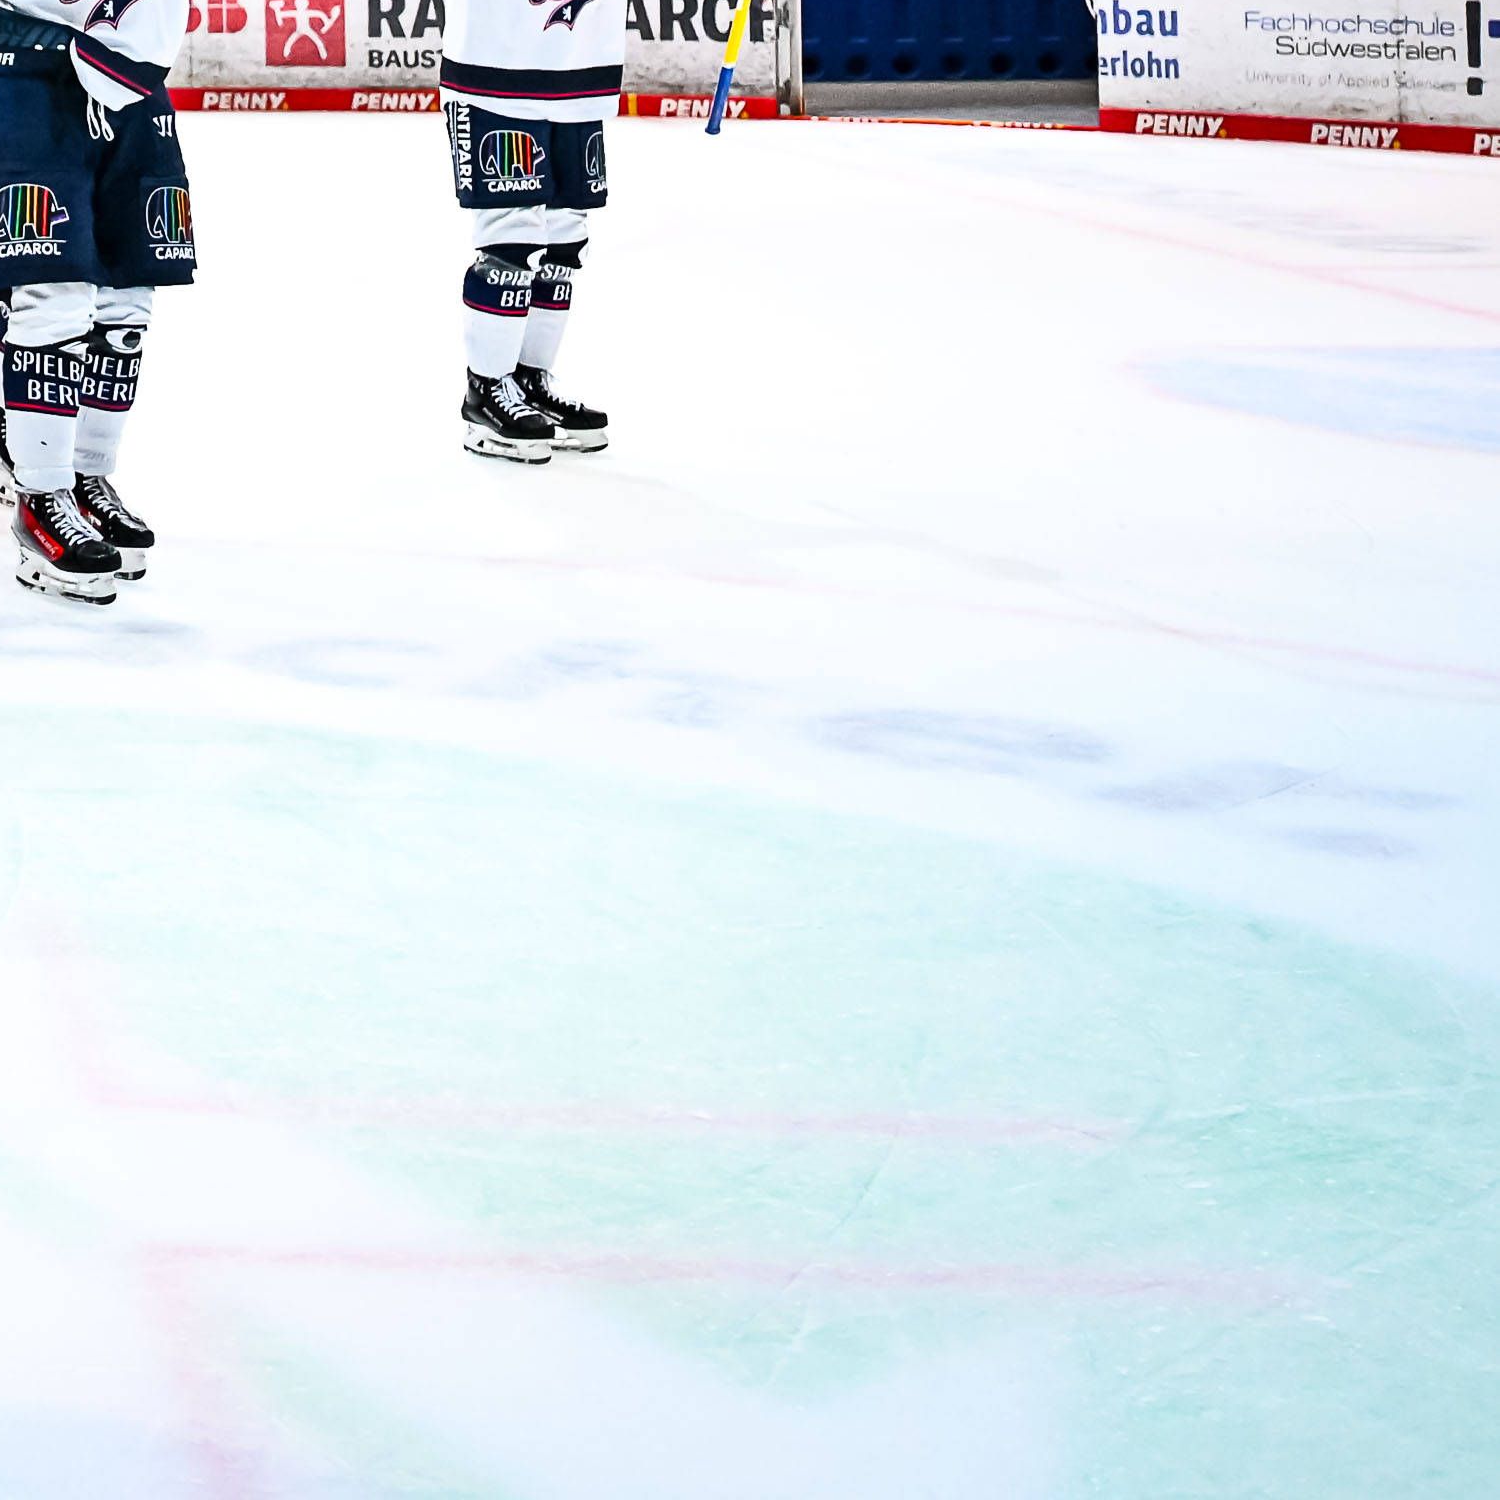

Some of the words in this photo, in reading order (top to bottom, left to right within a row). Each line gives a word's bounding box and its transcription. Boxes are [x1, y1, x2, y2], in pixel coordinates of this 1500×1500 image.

[1244, 10, 1456, 40] Fachhochschule
[1275, 35, 1458, 63] Südwestfalen
[488, 178, 542, 193] CAPAROL
